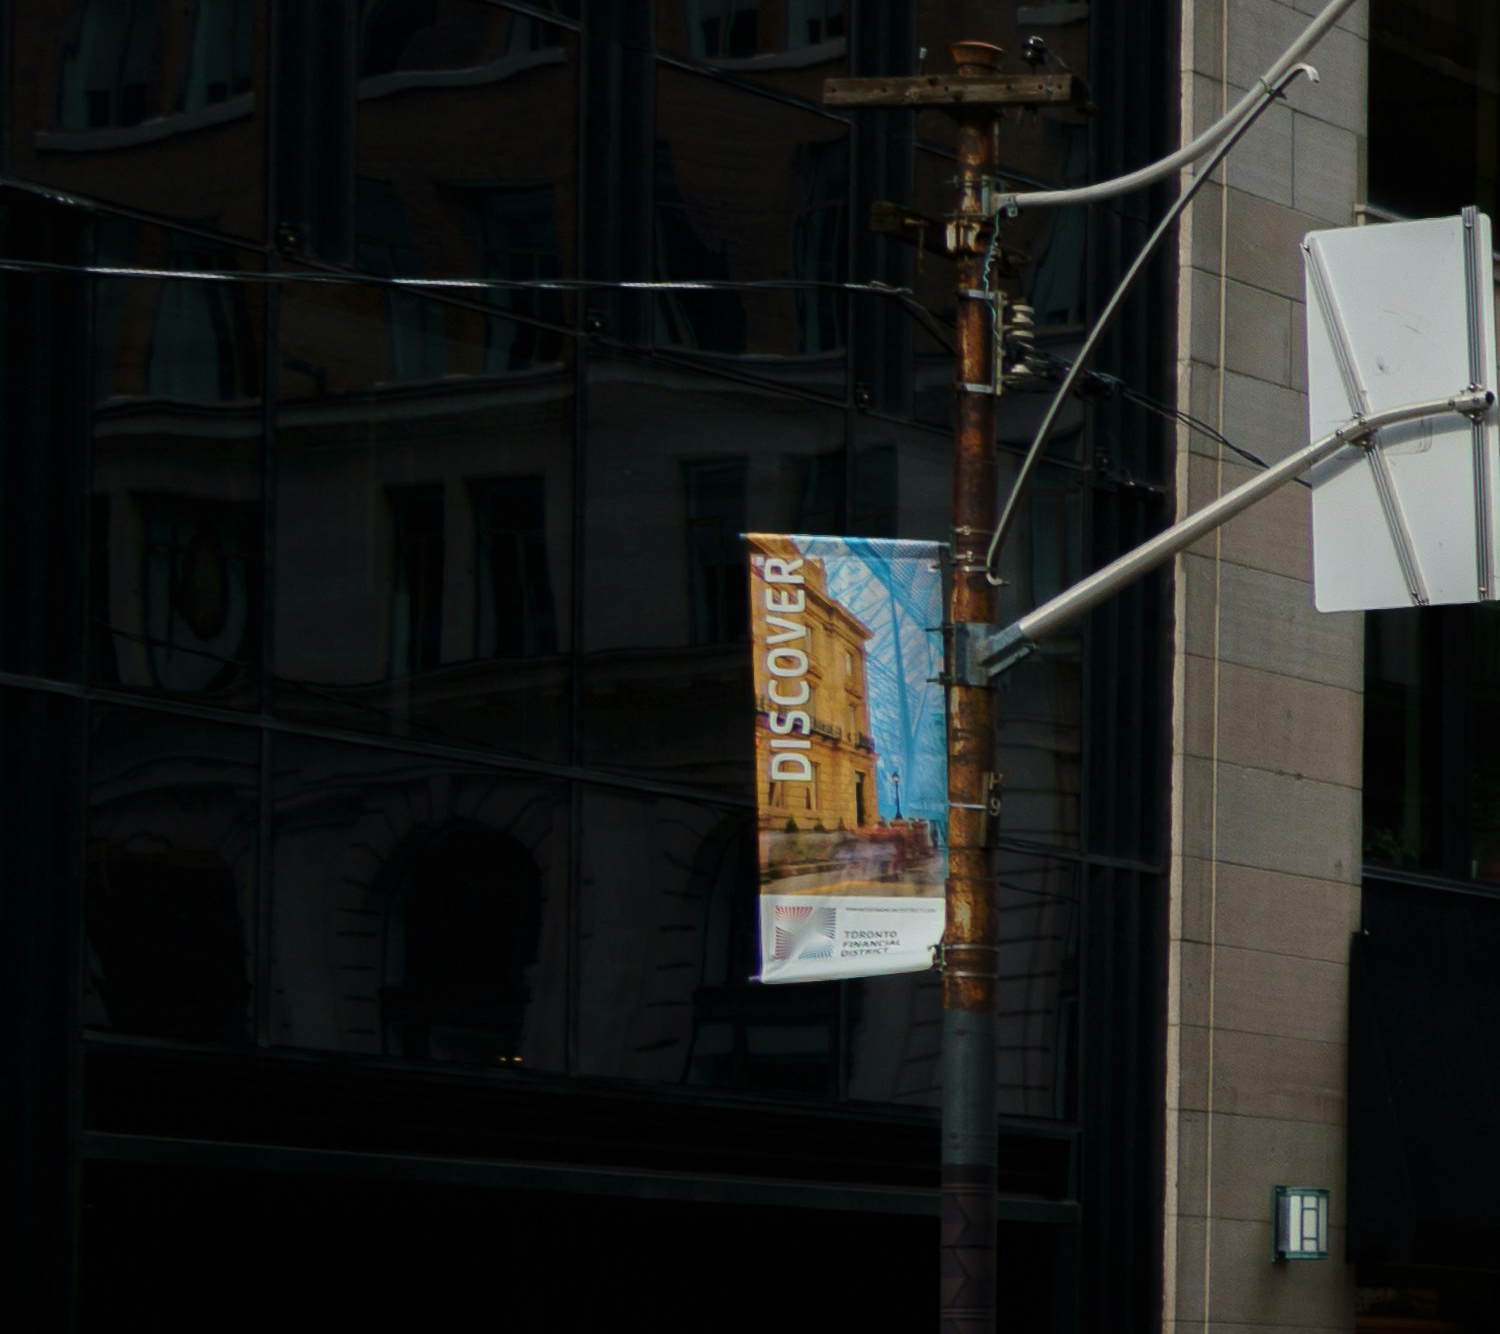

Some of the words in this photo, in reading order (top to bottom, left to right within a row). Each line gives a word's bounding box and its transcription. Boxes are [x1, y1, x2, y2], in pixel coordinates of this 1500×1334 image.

[764, 557, 812, 782] DISCOVER
[844, 930, 898, 939] TORONTO
[842, 939, 901, 948] FINANCIAL
[840, 948, 888, 957] DISTRICT
